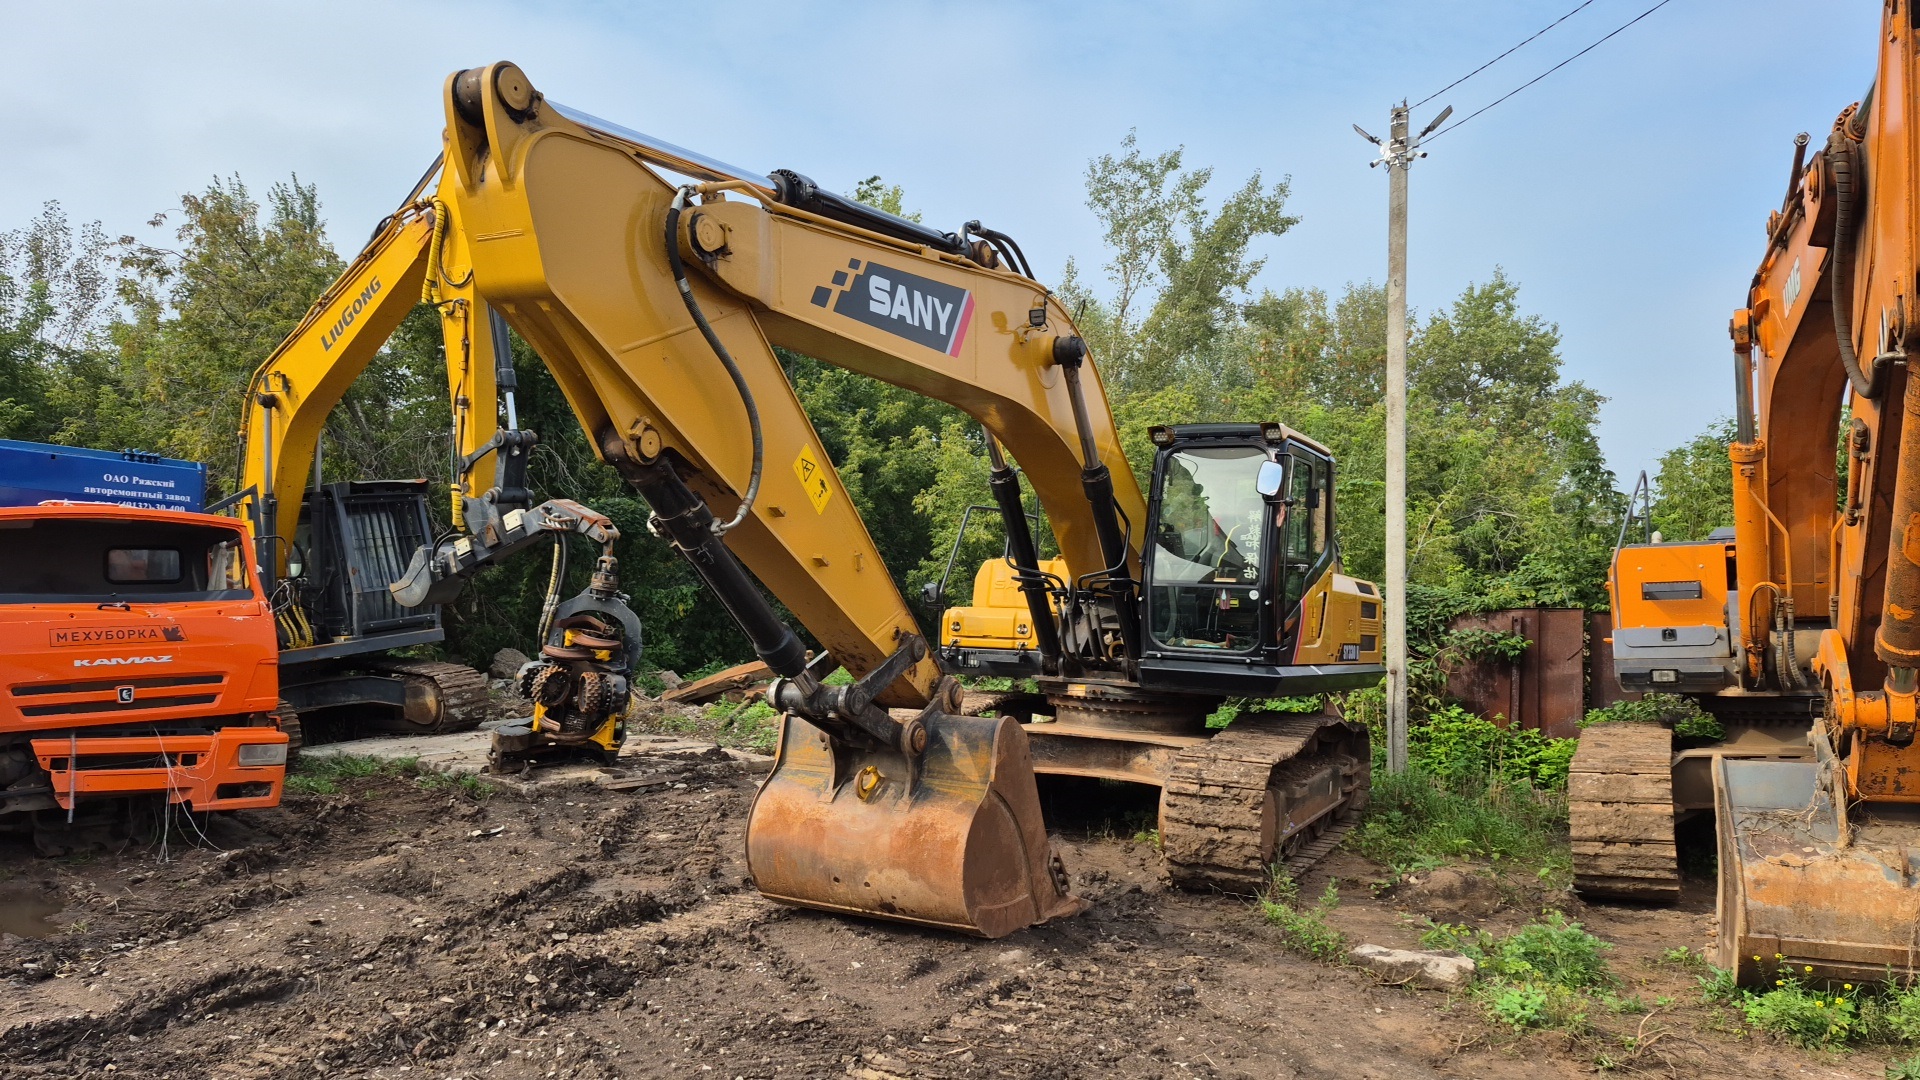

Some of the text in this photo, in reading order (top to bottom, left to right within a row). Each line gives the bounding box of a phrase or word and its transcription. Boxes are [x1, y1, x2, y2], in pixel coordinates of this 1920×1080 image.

[869, 274, 953, 336] SANY
[321, 275, 381, 351] LIUGONG
[103, 473, 175, 488] ОАО Ряжский
[84, 486, 191, 502] авторемонтный завод
[56, 628, 158, 642] МЕХУБОРКА
[73, 655, 172, 667] KAMAZ
